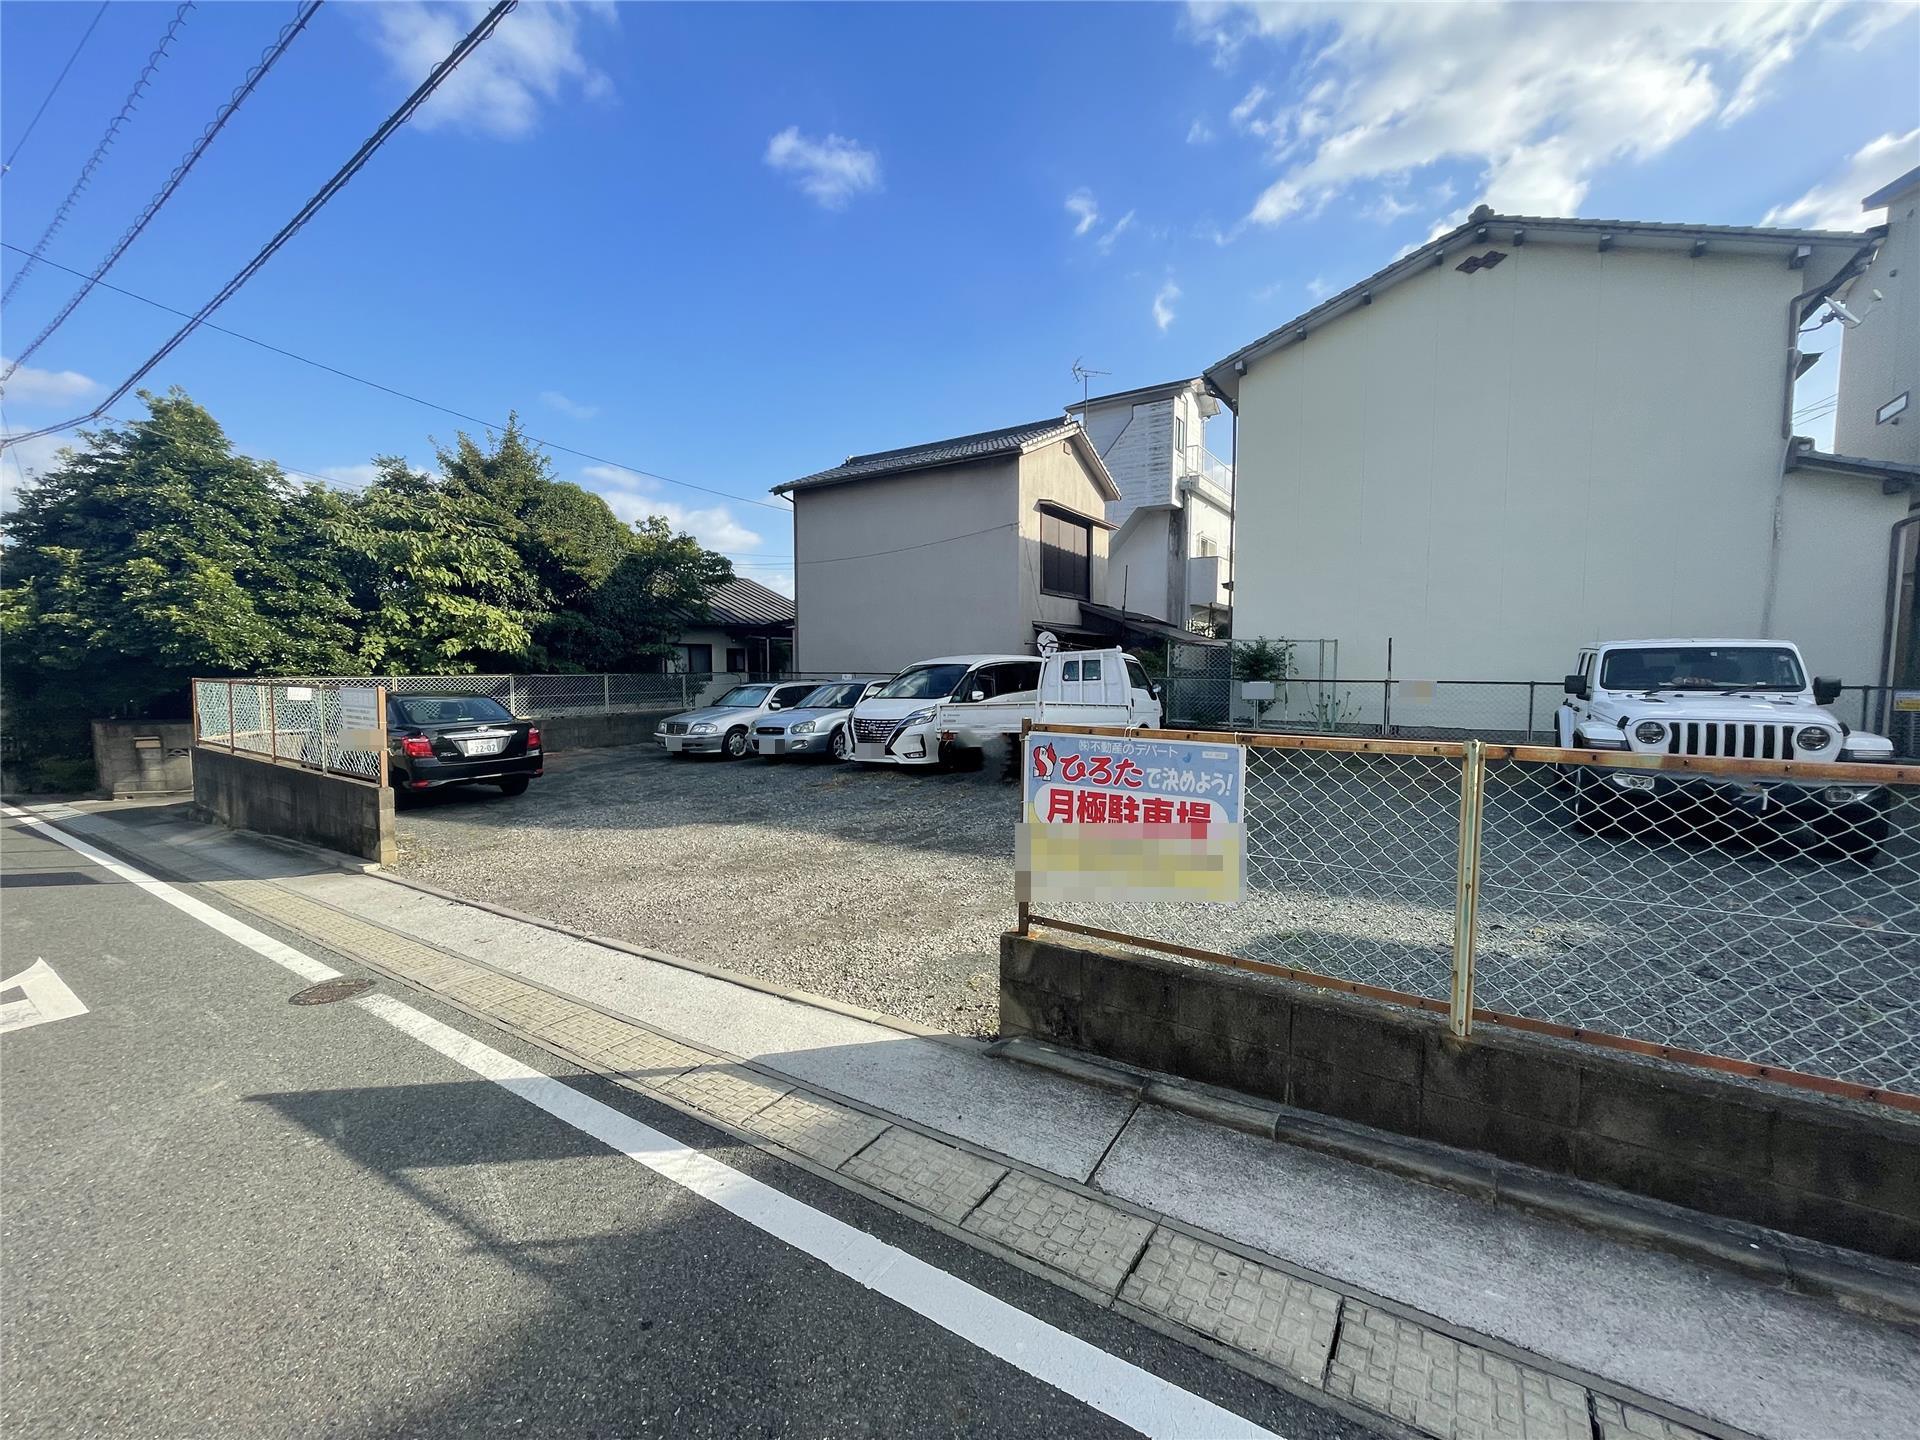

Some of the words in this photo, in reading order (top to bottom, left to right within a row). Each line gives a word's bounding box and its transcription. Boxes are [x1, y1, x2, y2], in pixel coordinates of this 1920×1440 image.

[1047, 788, 1212, 824] 月極駐車場
